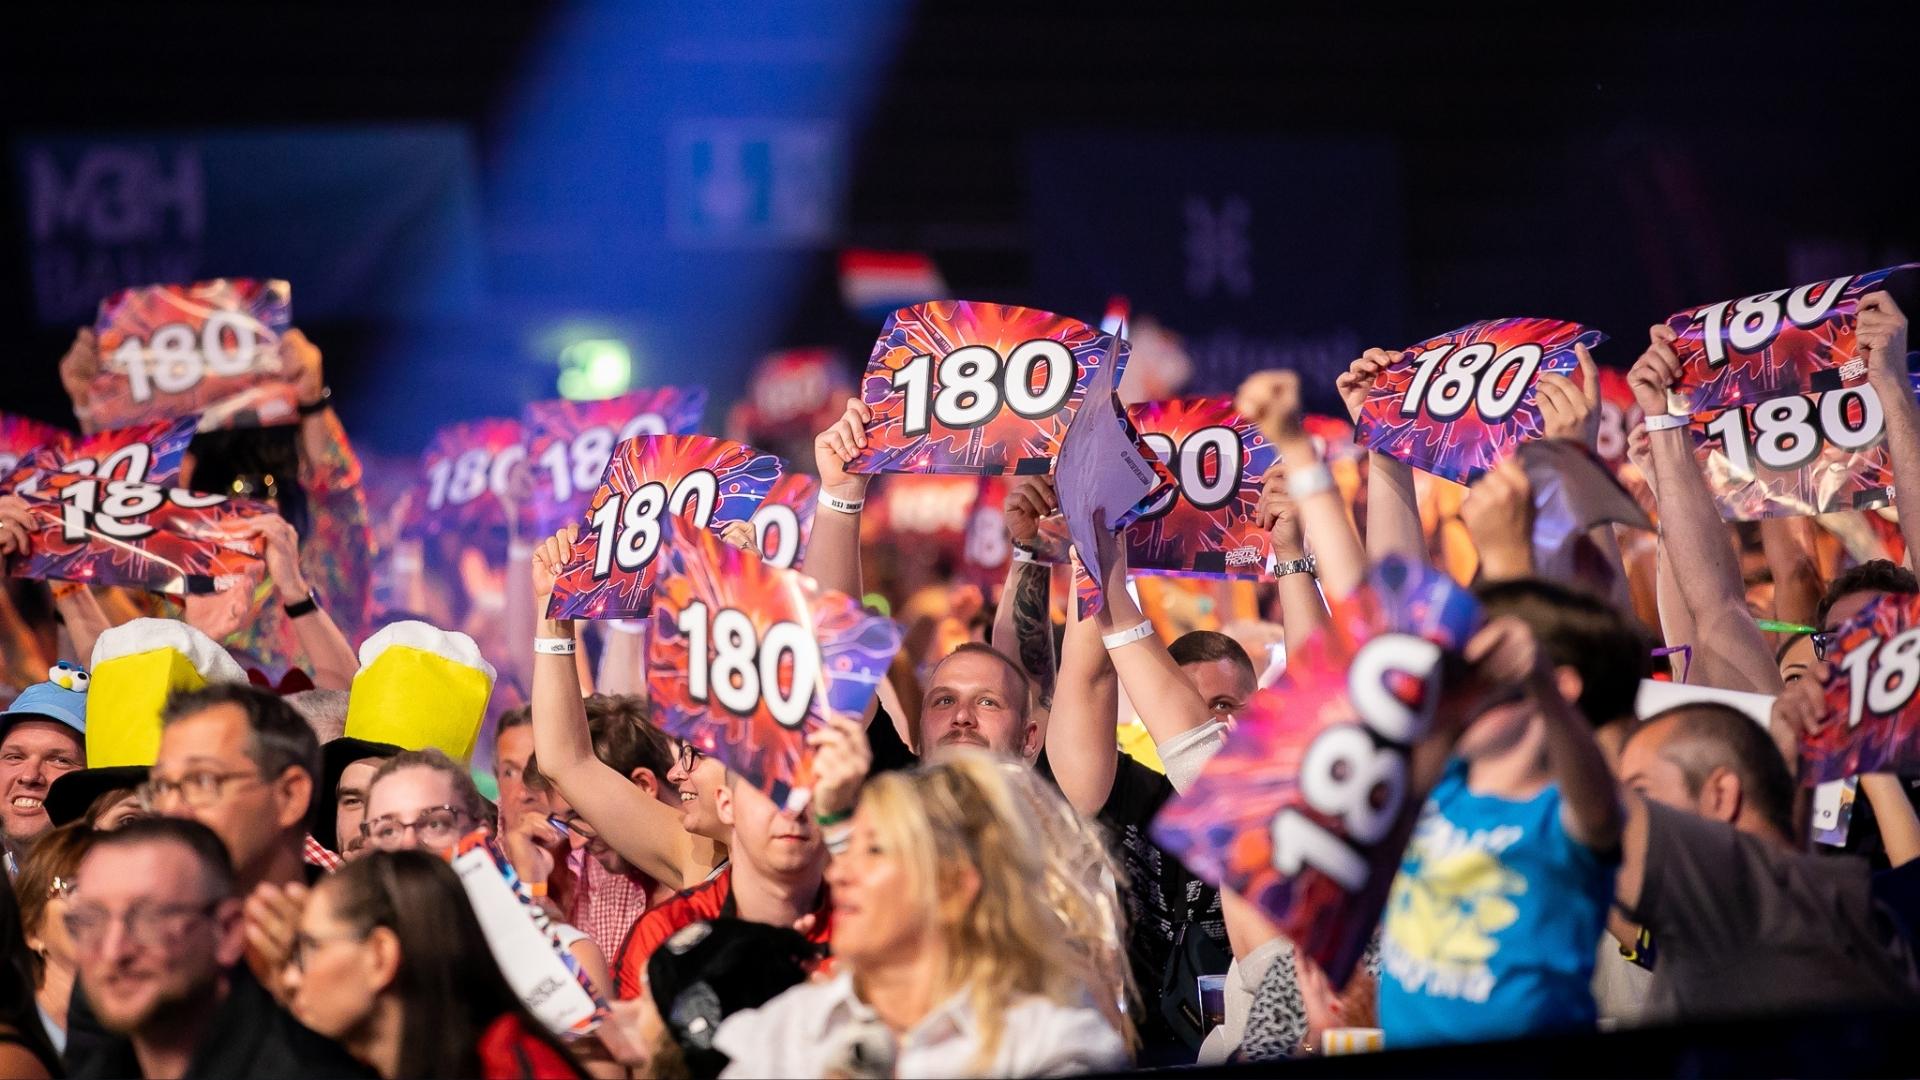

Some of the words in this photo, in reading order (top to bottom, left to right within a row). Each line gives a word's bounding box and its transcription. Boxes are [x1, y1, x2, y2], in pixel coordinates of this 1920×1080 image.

[113, 311, 256, 402] 180
[1694, 275, 1853, 369] 180
[893, 339, 1075, 435] 180
[1400, 341, 1543, 423] 180
[1706, 382, 1885, 478] 180
[590, 468, 719, 580] 180
[678, 599, 818, 728] 180
[1271, 632, 1442, 892] 180
